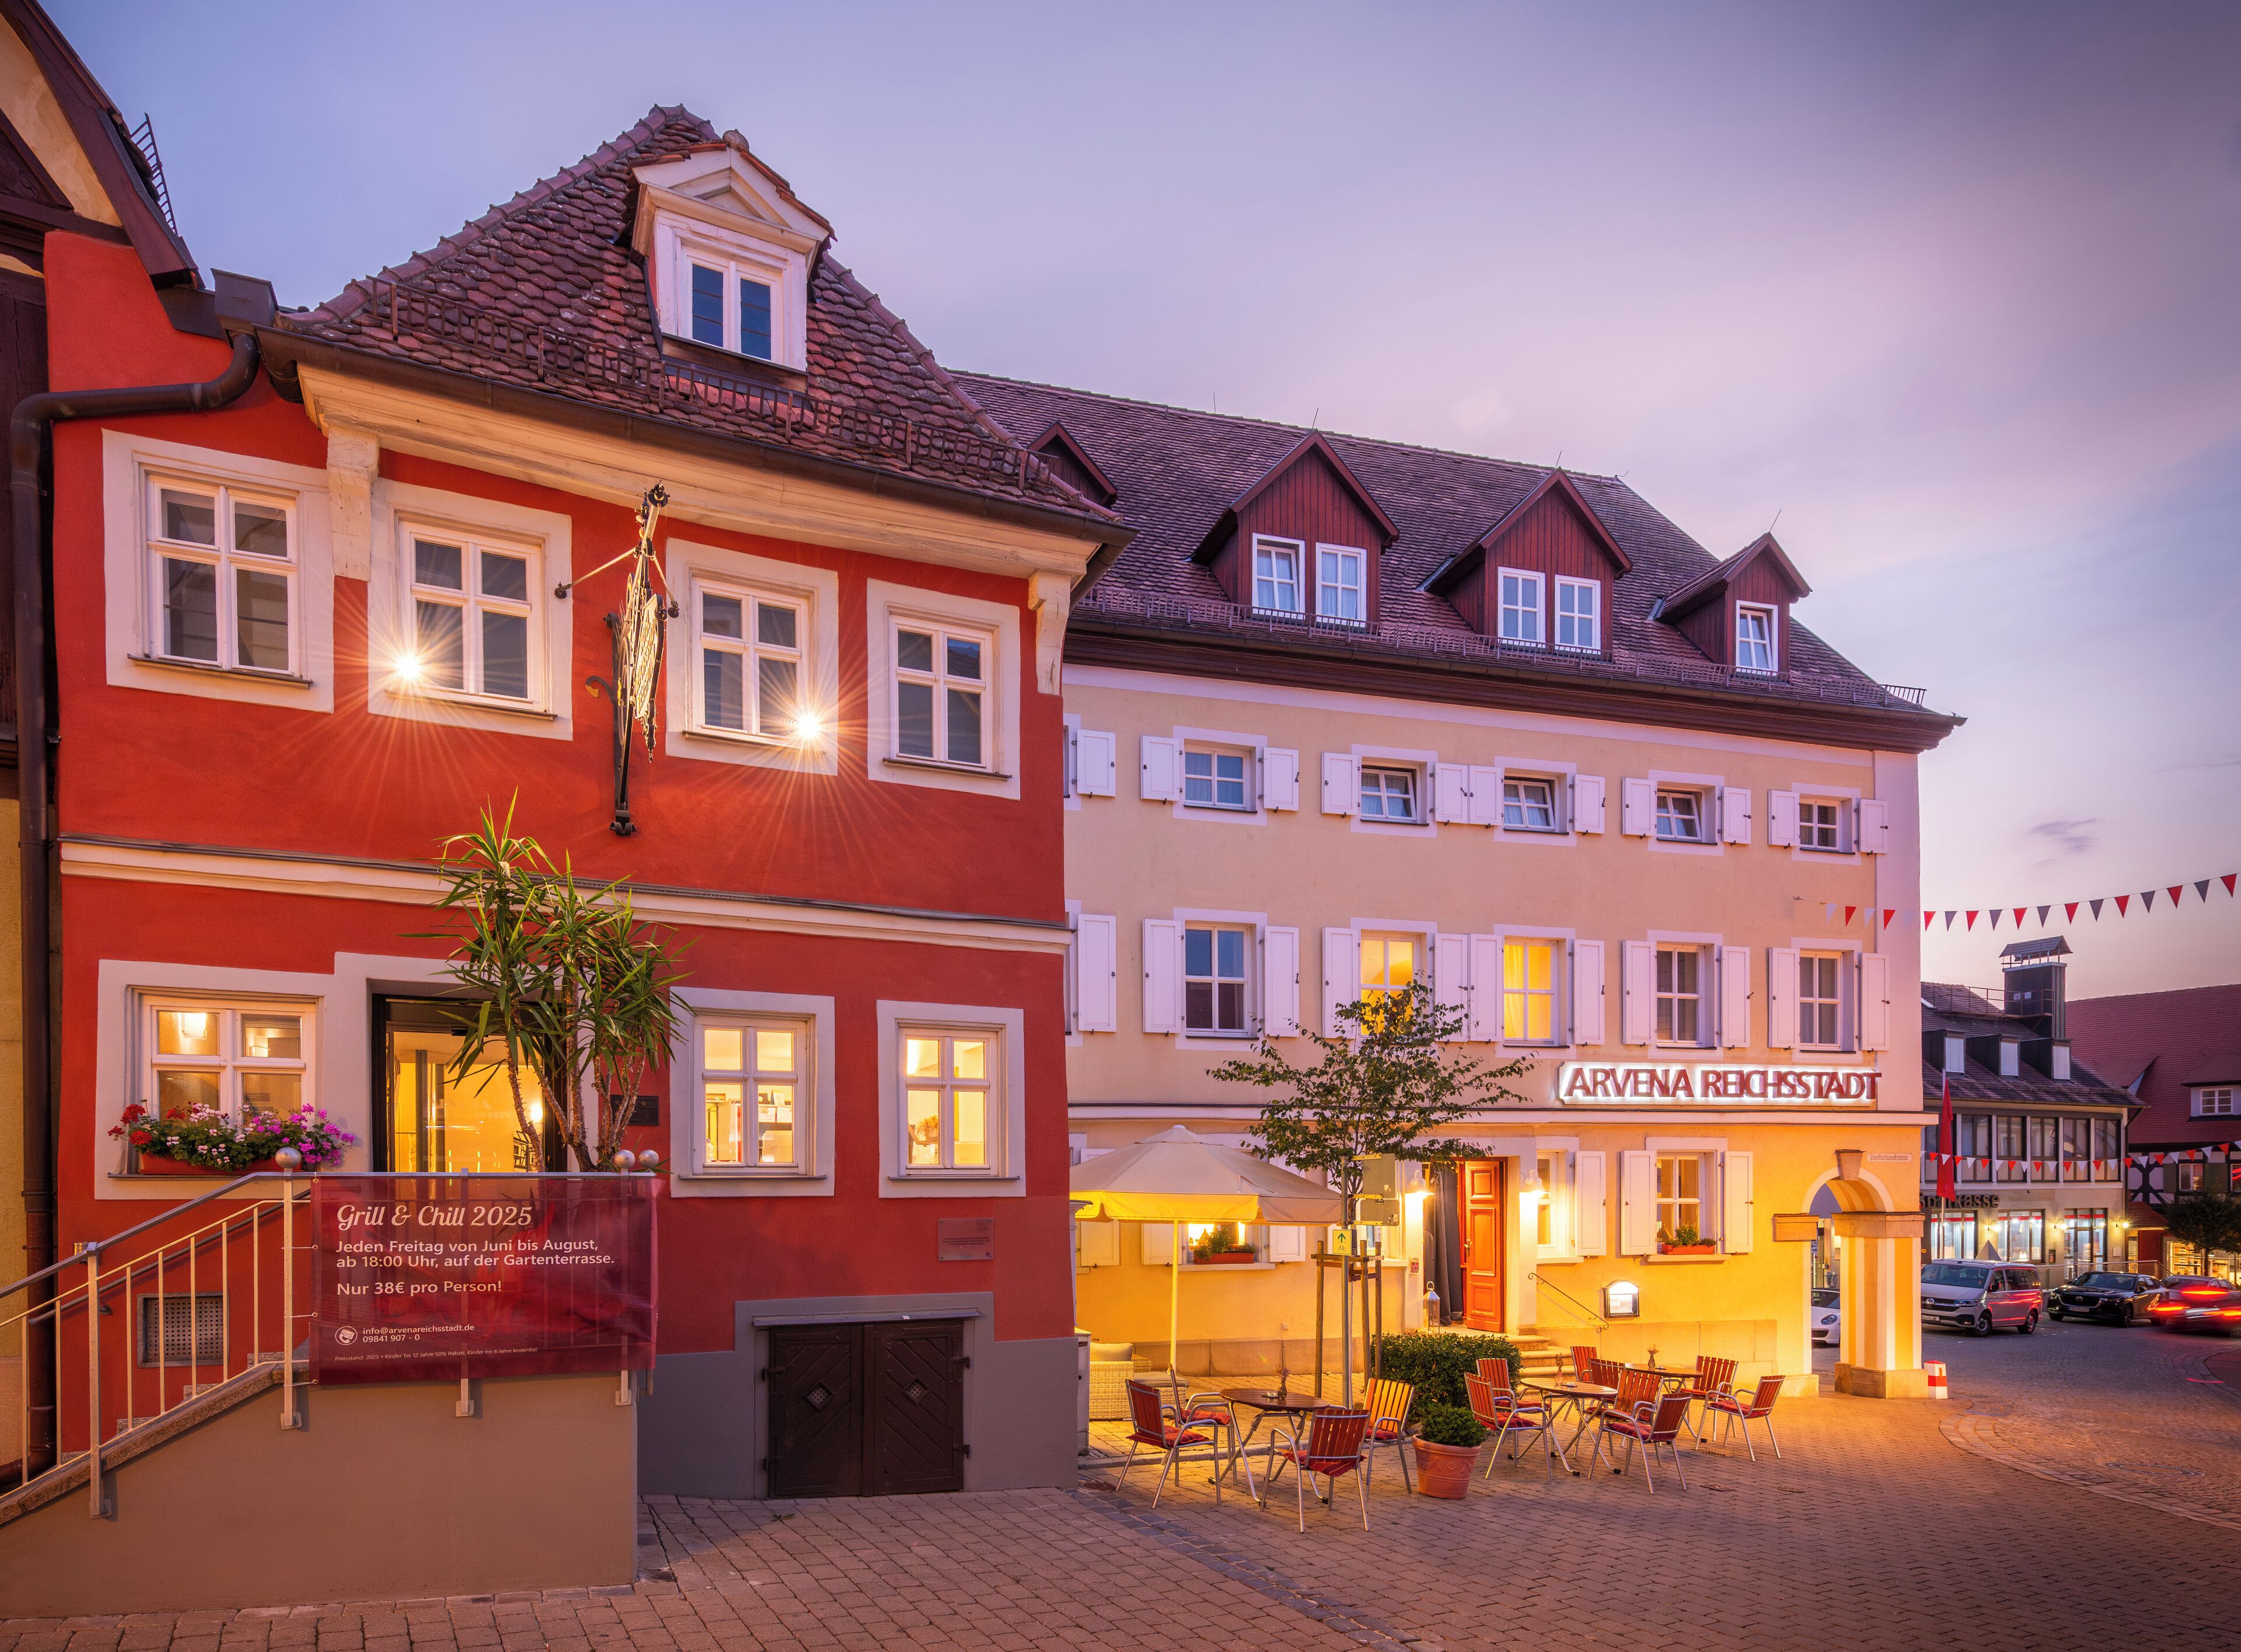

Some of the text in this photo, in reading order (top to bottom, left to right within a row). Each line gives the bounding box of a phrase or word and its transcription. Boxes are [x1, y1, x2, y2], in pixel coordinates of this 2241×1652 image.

[1564, 1068, 1882, 1099] ARVENA REICHSSTADT
[337, 1205, 532, 1231] Grill & Chill 2025
[336, 1239, 598, 1255] Jeden Freitag von Juni bis August,
[336, 1254, 614, 1268] ab 18:00 Uhr, auf der Gartenterrasse.
[337, 1281, 501, 1297] Nur 38€ pro Person!
[363, 1324, 474, 1335] info@arvenareichsstadt.de
